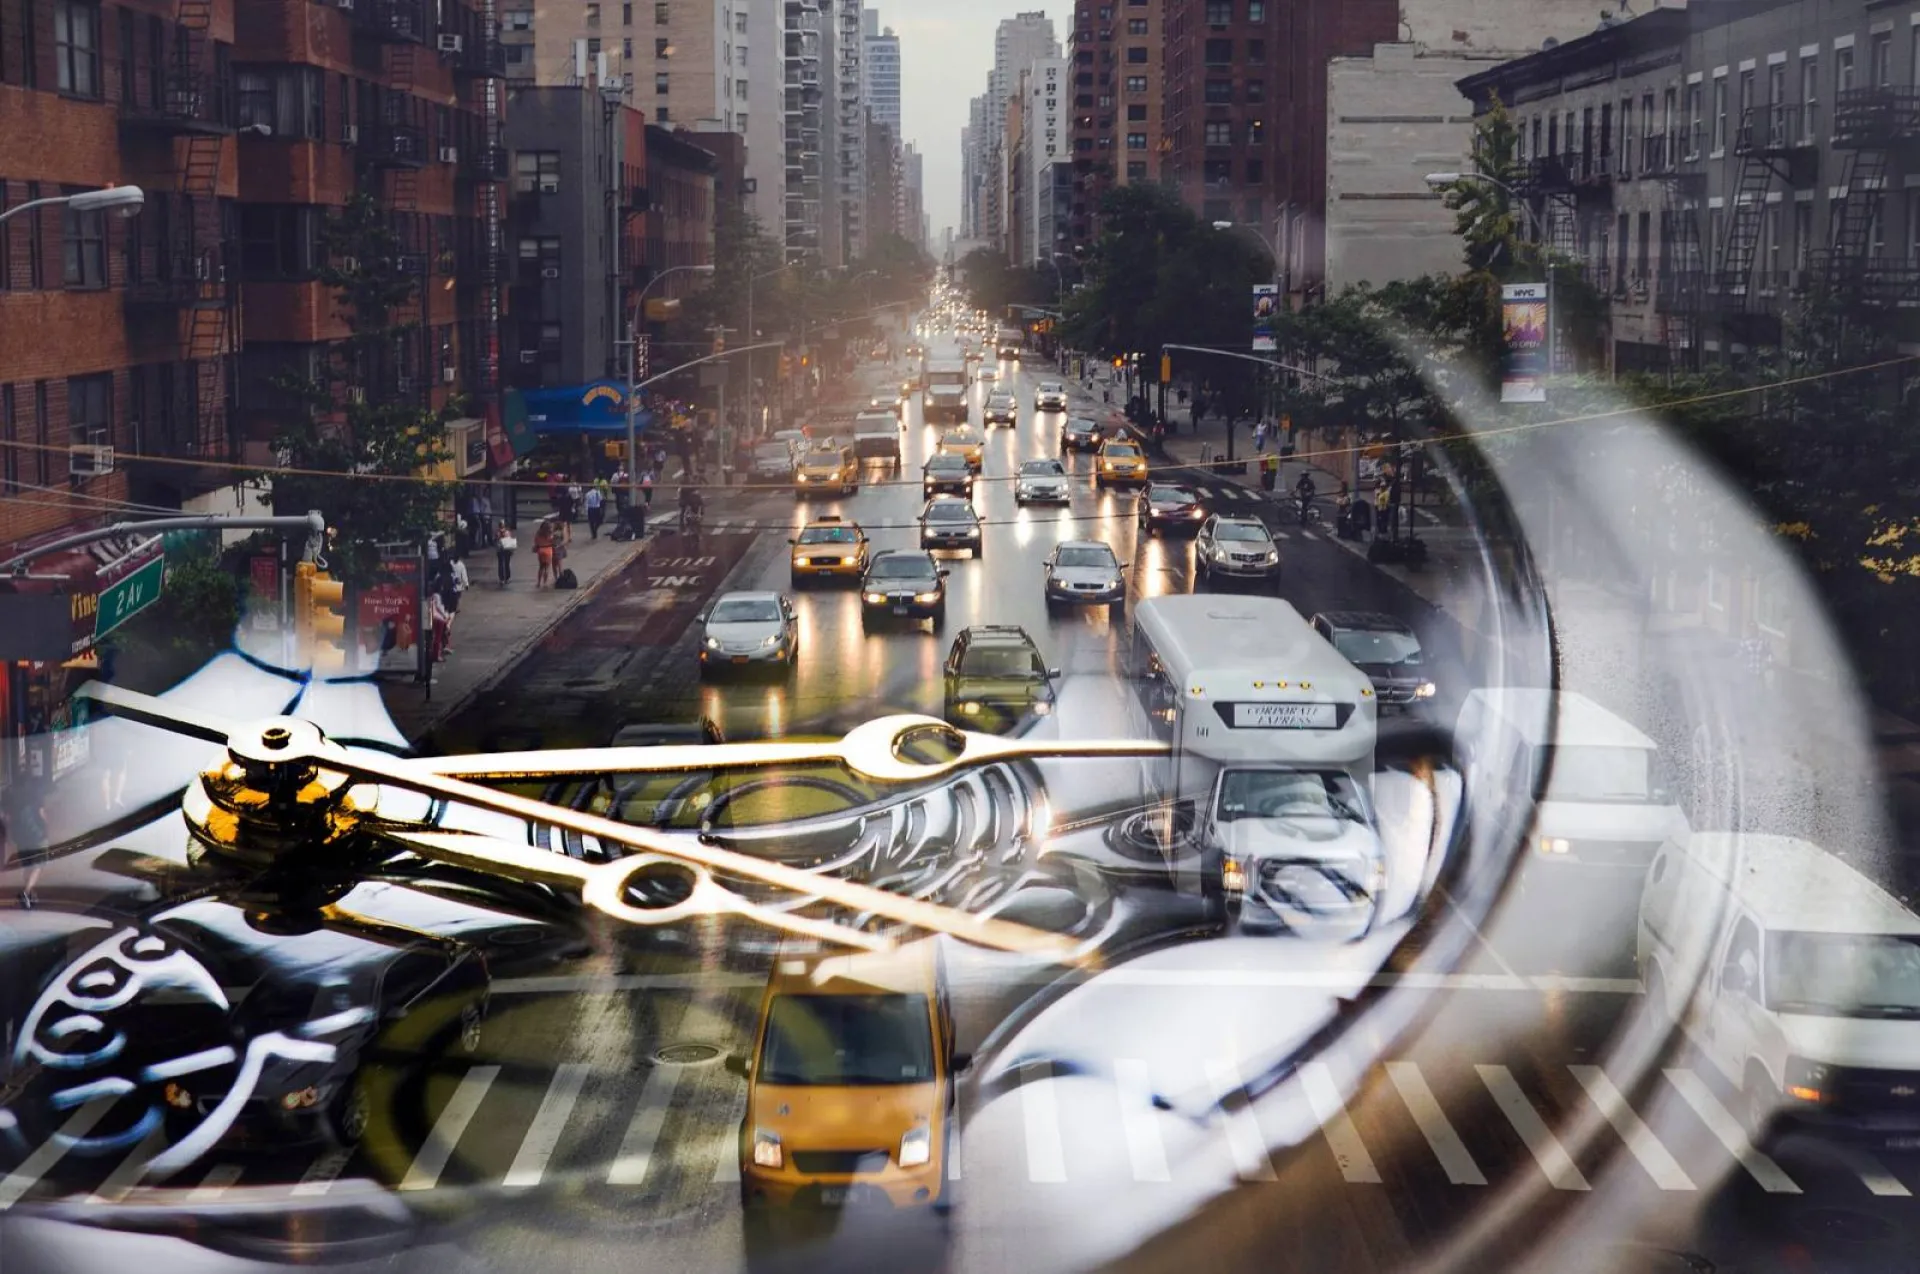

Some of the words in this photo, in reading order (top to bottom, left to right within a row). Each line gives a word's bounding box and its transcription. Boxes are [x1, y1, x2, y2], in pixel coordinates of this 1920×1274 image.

[1513, 288, 1536, 297] NYC
[115, 589, 125, 617] 2
[1247, 706, 1318, 715] CORPORATE
